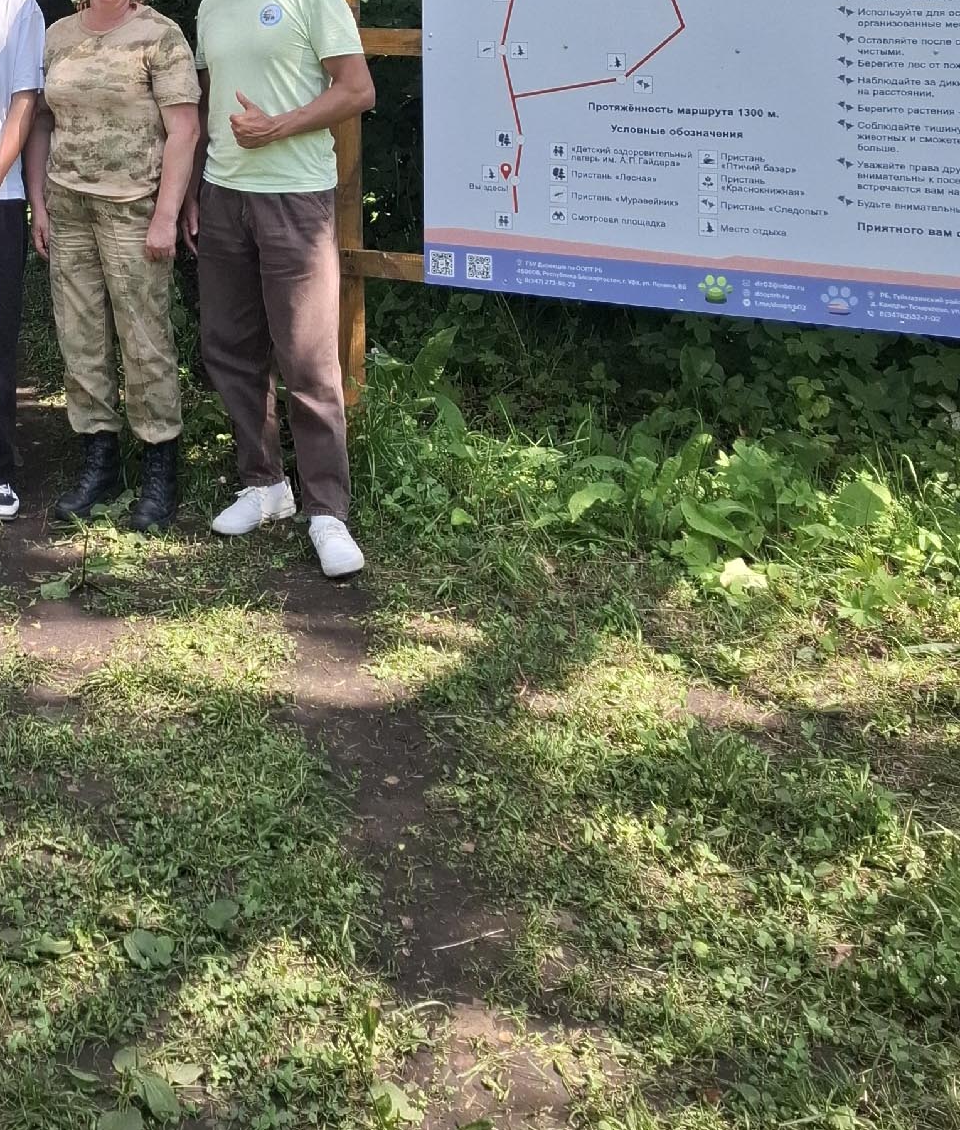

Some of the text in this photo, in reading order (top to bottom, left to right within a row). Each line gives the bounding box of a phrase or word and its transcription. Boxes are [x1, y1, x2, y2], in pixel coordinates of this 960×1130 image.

[857, 8, 923, 18] Используйте
[857, 20, 942, 28] организованные
[857, 35, 952, 46] Оставляйте после
[857, 59, 940, 69] Берегите лес от
[857, 76, 936, 86] Наблюдайте за
[872, 89, 935, 98] расстоянии.
[588, 101, 780, 119] Протяжённость маршрута 1300 м.
[857, 104, 955, 116] Берегите растения
[611, 123, 744, 139] Условные обозначения
[857, 121, 921, 132] Соблюдайте
[857, 134, 906, 142] животных
[857, 143, 900, 153] больше.
[571, 155, 600, 163] лагерь
[720, 152, 766, 163] Пристань
[857, 160, 940, 173] Уважайте права
[571, 170, 612, 180] Пристань
[720, 174, 766, 185] Пристань
[857, 173, 925, 183] внимательны
[857, 183, 921, 194] встречаются
[924, 187, 945, 195] вам
[571, 191, 612, 202] Пристань
[720, 201, 765, 212] Пристань
[857, 199, 892, 209] Будьте
[571, 213, 666, 228] Смотровая площадка
[720, 224, 787, 237] Место отдыха
[857, 221, 953, 238] Приятного вам
